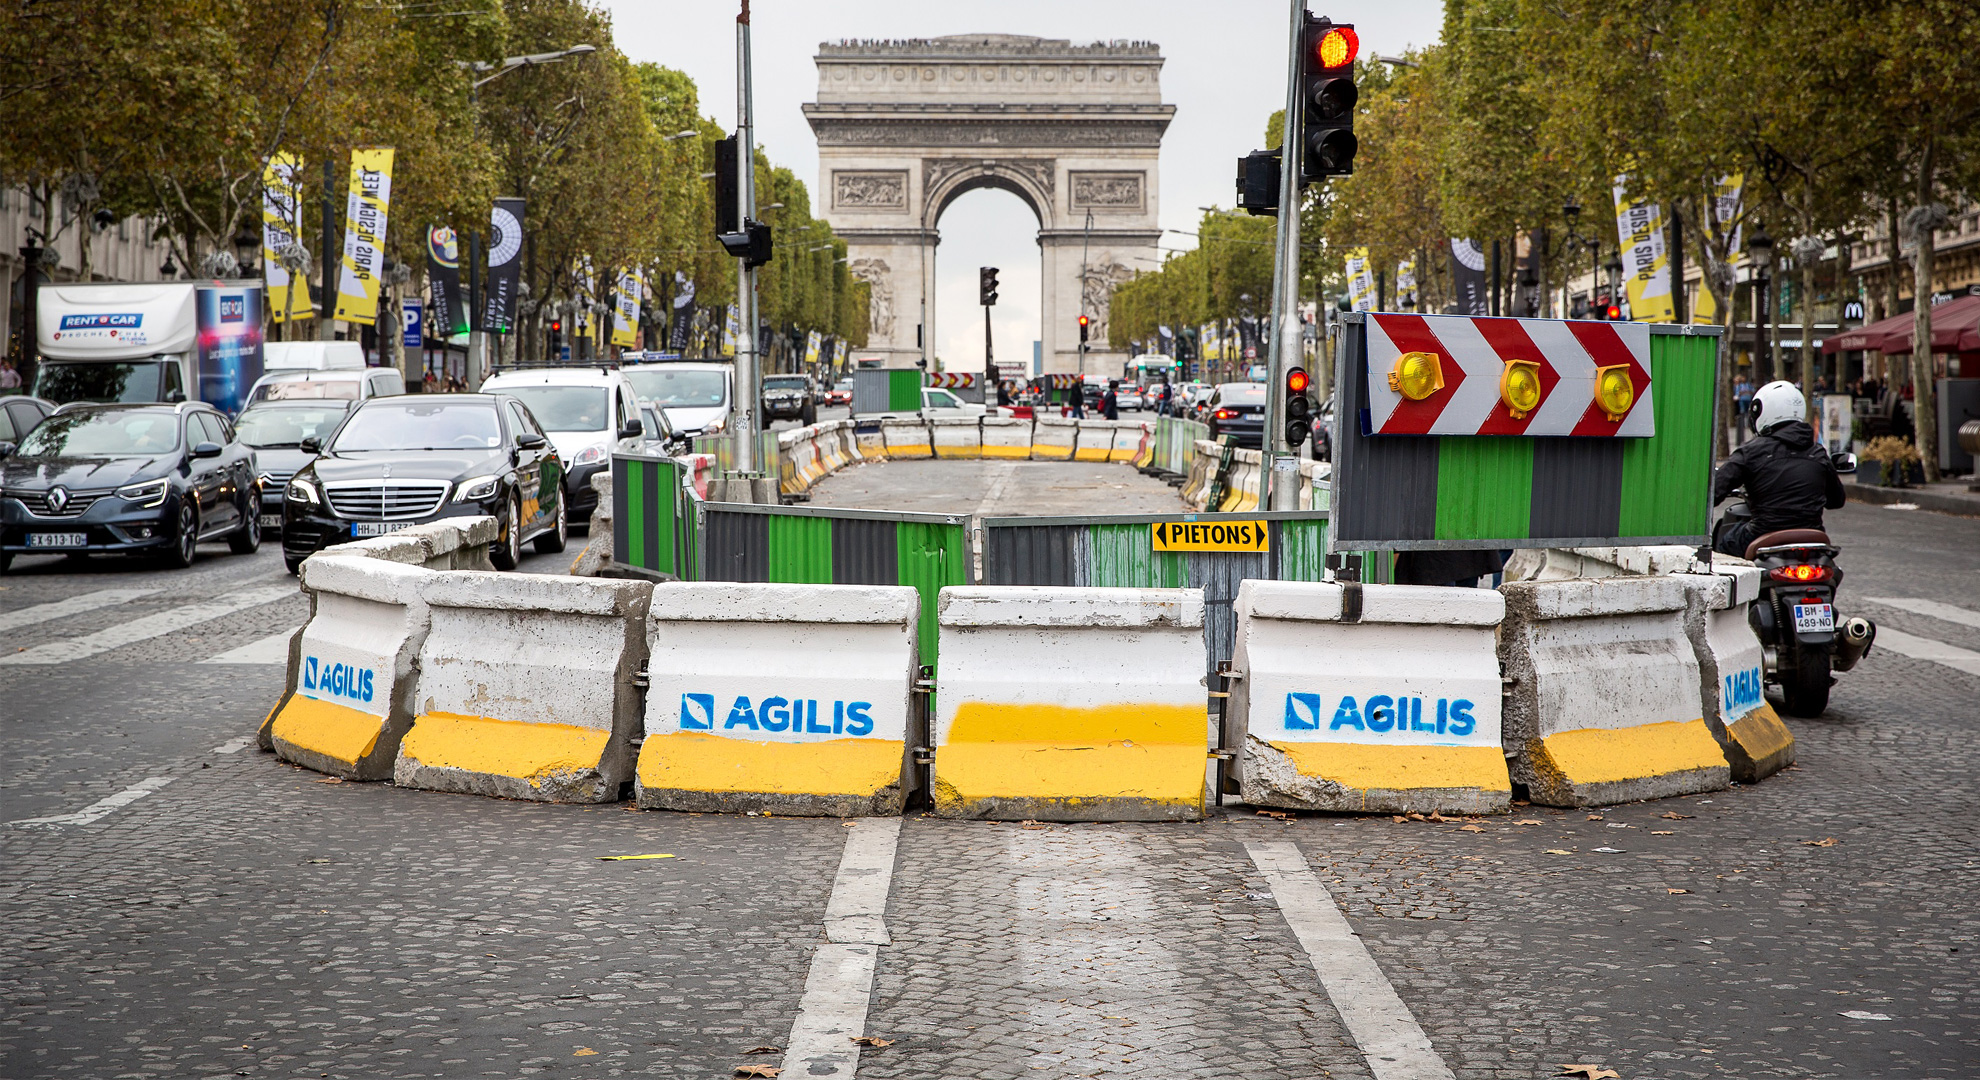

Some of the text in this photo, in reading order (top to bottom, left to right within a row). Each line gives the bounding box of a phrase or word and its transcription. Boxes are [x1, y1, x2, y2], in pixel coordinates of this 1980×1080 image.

[1629, 202, 1656, 280] PARIS DESIGN
[66, 316, 99, 326] RENT
[110, 316, 136, 324] CAR
[403, 310, 419, 332] P
[358, 524, 370, 534] HH
[1172, 525, 1251, 544] PIETONS
[320, 663, 373, 702] AGILIS
[1733, 667, 1760, 705] AGILIS
[724, 696, 873, 736] AGILIS
[1330, 695, 1476, 736] AGILIS
